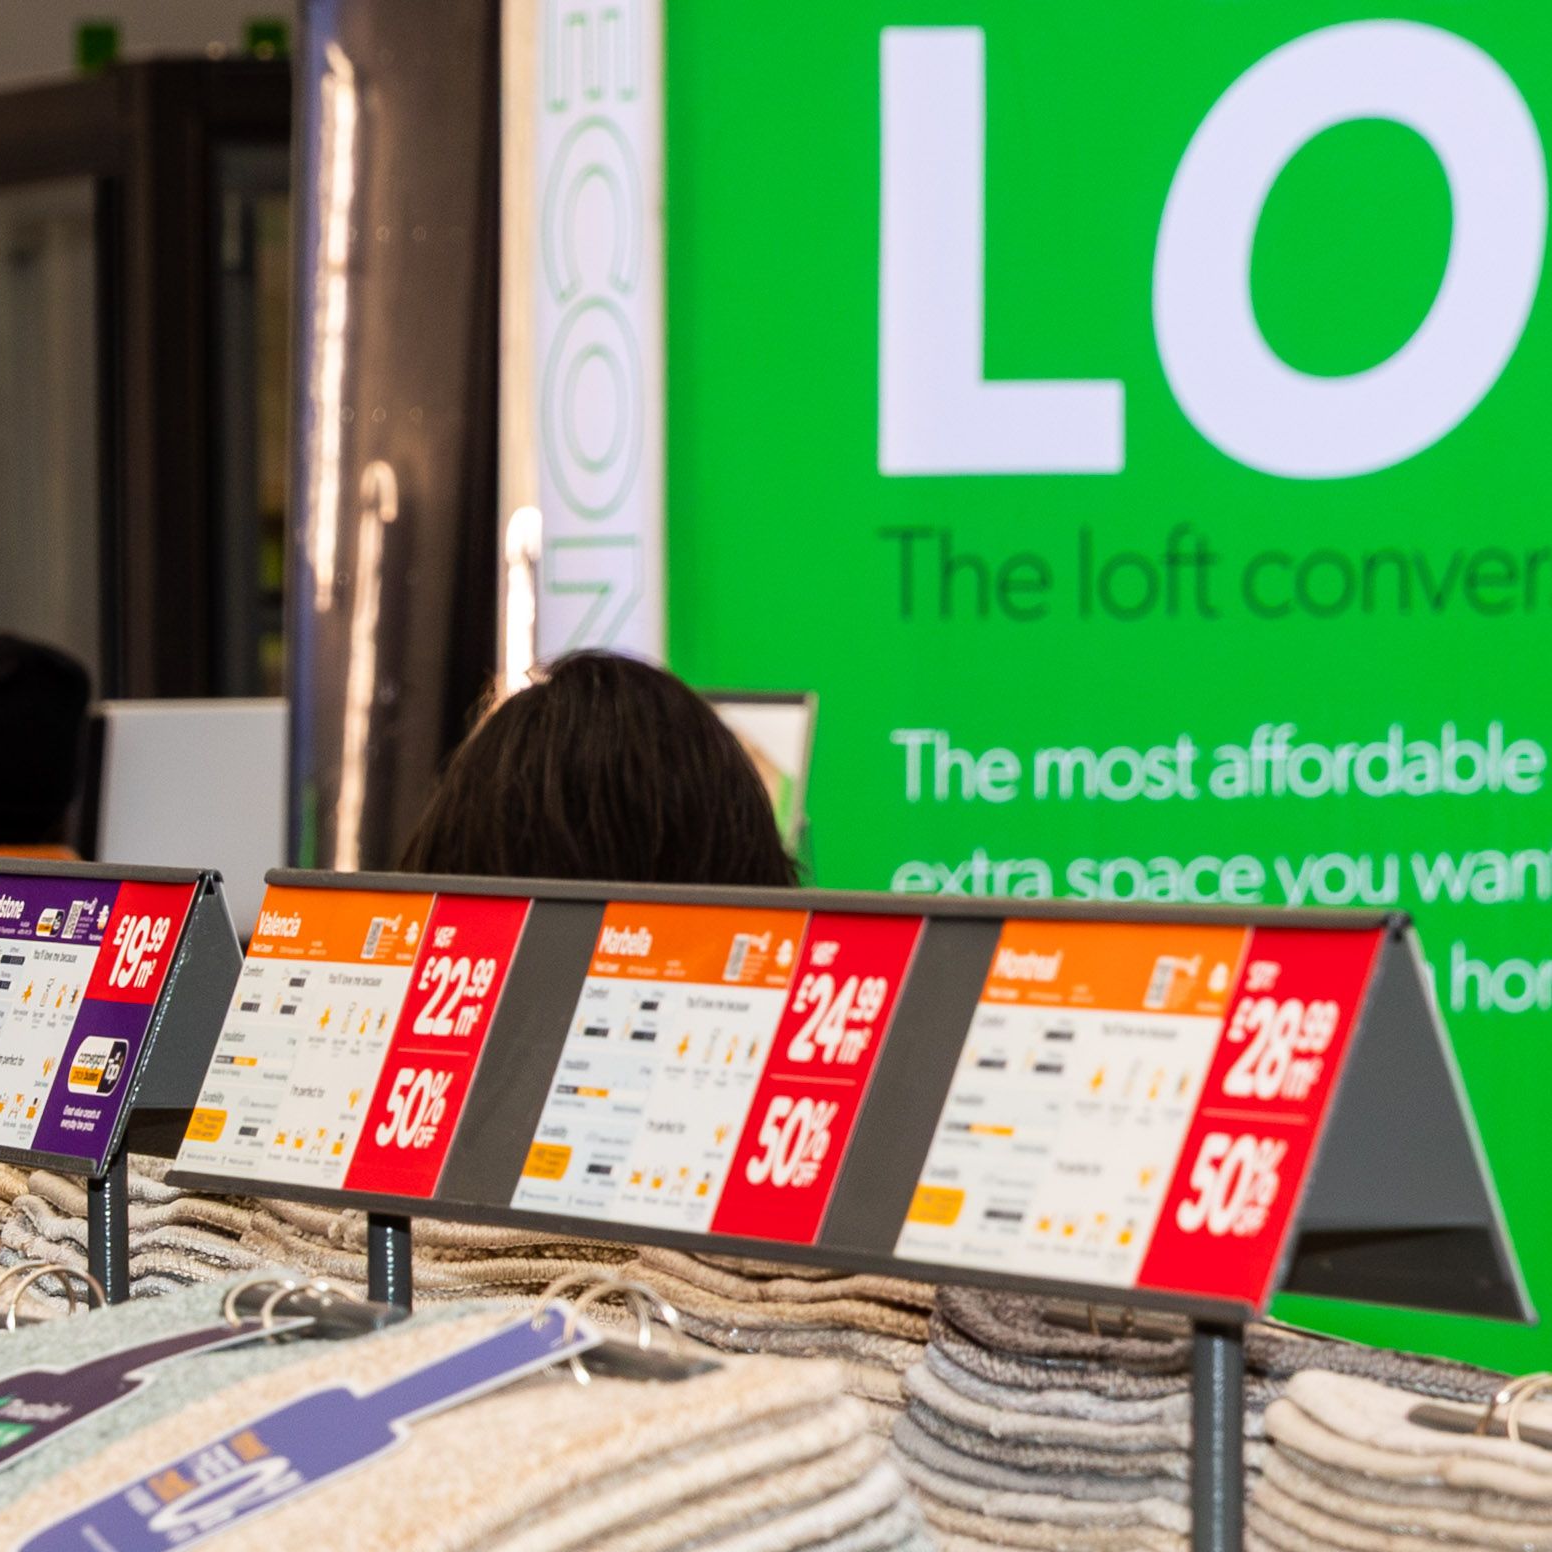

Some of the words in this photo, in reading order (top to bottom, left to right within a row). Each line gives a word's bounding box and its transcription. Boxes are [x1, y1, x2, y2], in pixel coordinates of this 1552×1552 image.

[877, 17, 1550, 481] LO
[876, 523, 1054, 622] The
[1078, 520, 1224, 622] loft
[889, 728, 1022, 802] The
[1033, 733, 1200, 802] most
[1208, 721, 1547, 799] affordable
[890, 847, 1054, 898] extra
[1067, 853, 1266, 902] space
[1272, 853, 1399, 909] you
[108, 914, 171, 989] £19.99
[257, 911, 302, 938] Valencia
[598, 926, 653, 957] Marbella
[133, 959, 157, 989] m²
[412, 956, 496, 1036] £22.99
[453, 1003, 483, 1037] m²
[787, 973, 888, 1064] £24.99
[1222, 997, 1340, 1100] £28.99
[375, 1068, 454, 1149] 50%
[414, 1126, 438, 1148] OFF
[746, 1096, 840, 1188] 50%
[1176, 1132, 1289, 1237] 50%
